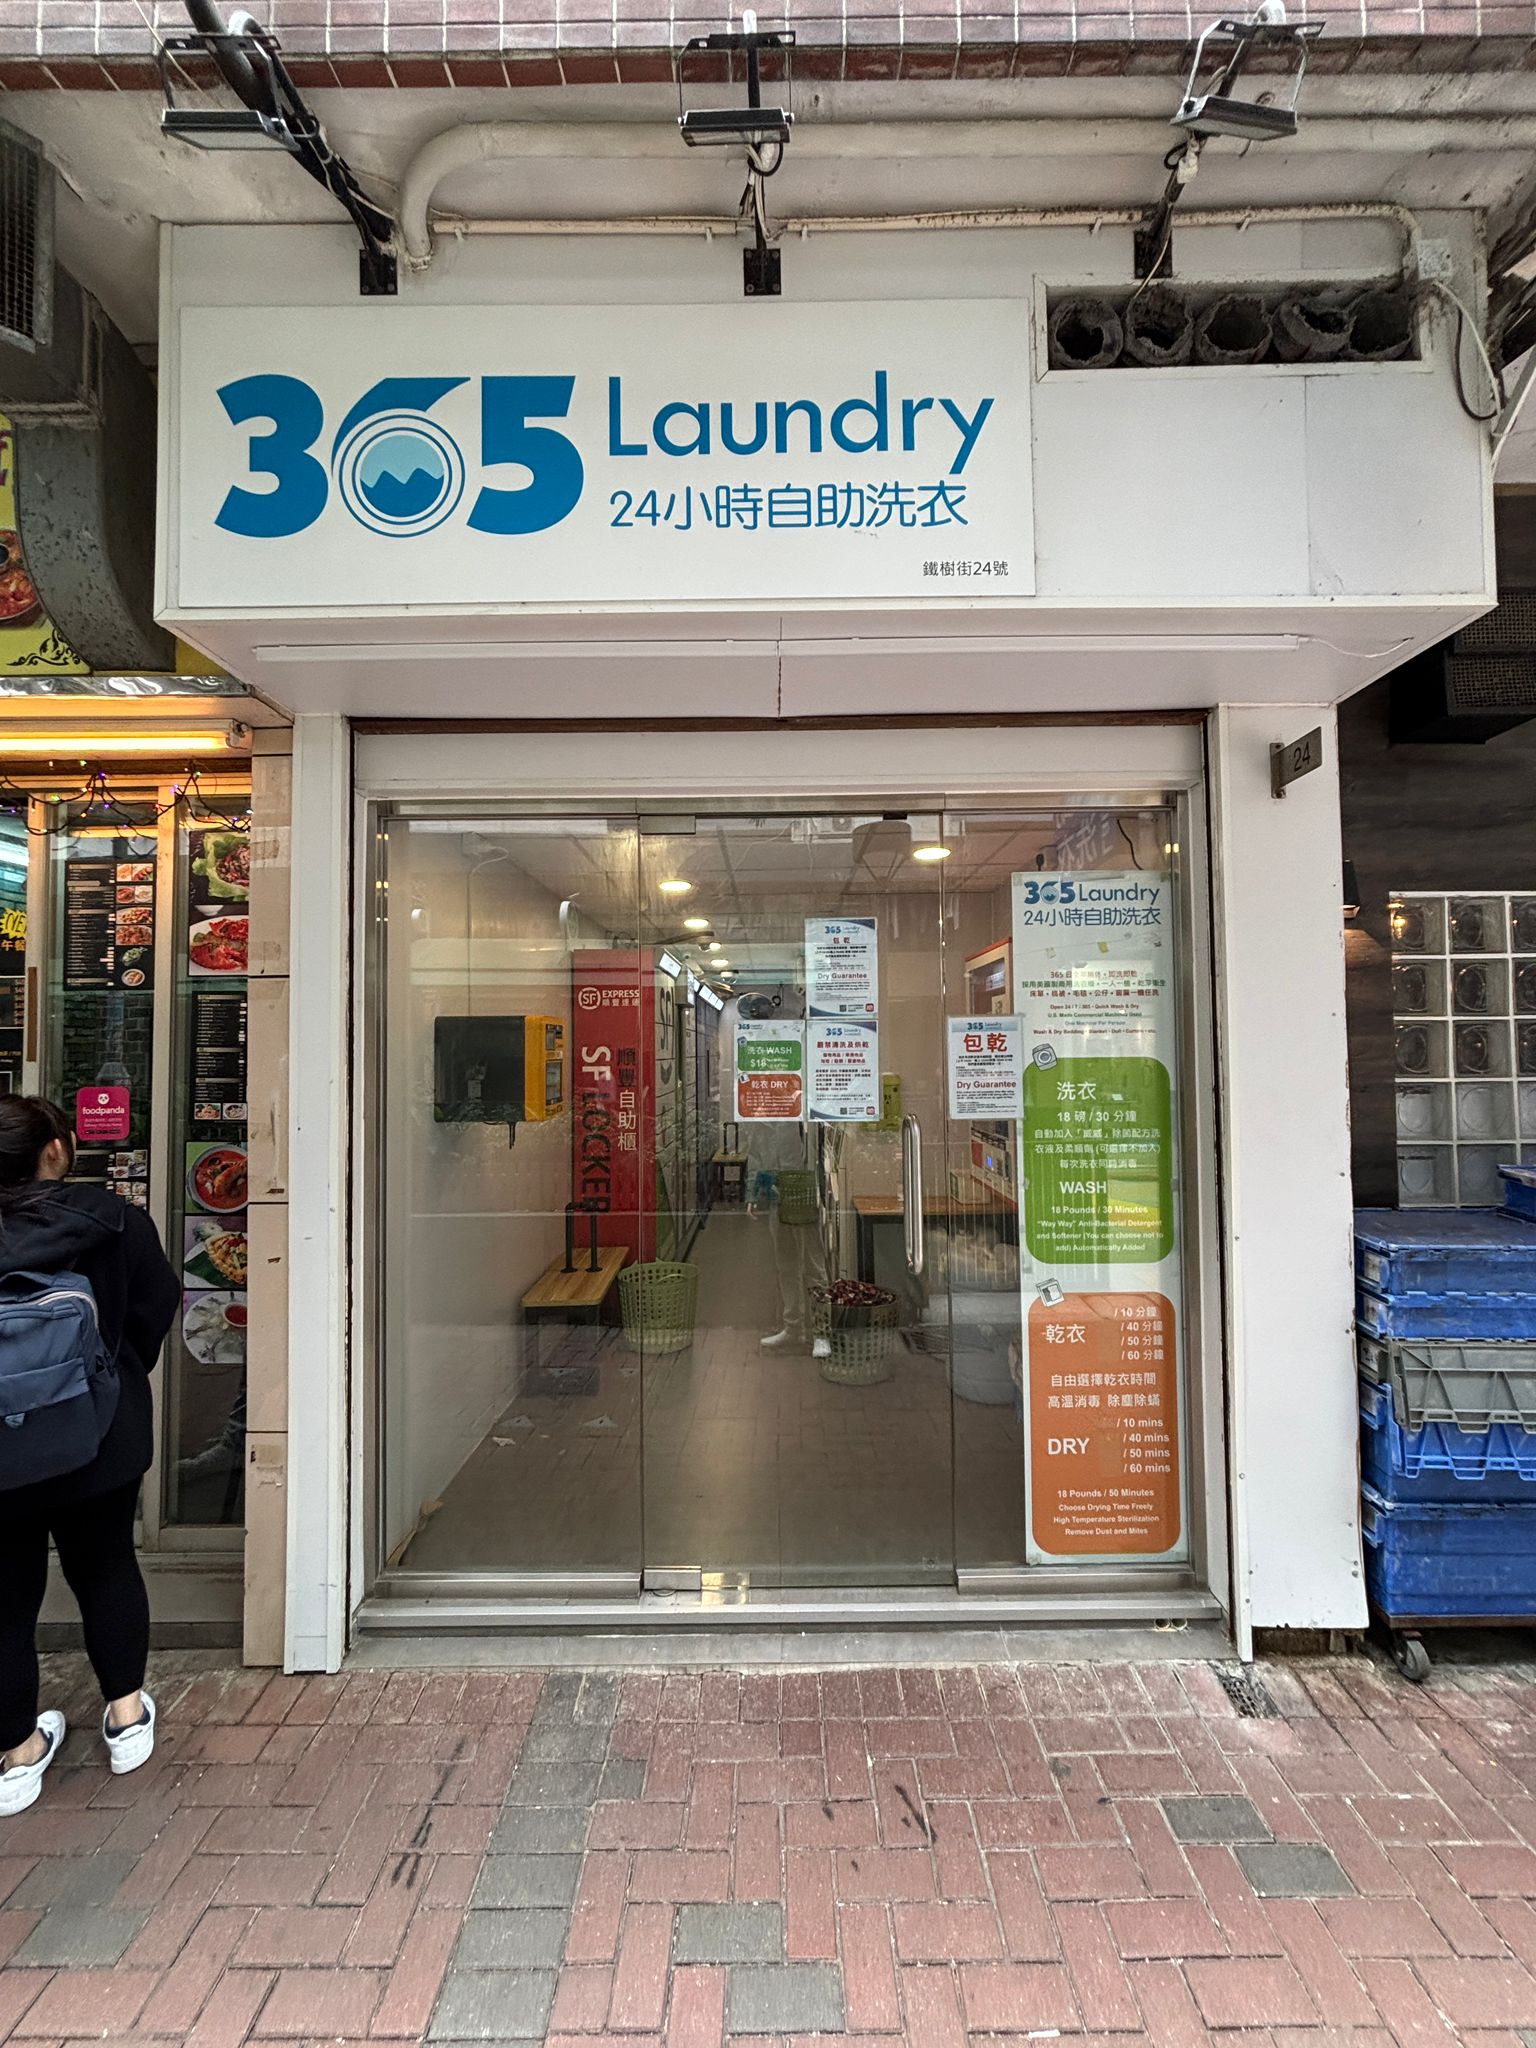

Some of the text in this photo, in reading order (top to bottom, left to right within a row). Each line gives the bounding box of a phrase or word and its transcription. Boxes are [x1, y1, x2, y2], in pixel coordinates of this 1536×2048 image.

[214, 370, 995, 538] 365 Laundry
[610, 480, 968, 530] 24小時自助洗衣
[922, 561, 1009, 576] 鐵樹街24號
[1293, 741, 1311, 772] 24
[1023, 880, 1160, 907] 365 Laundry
[1023, 907, 1162, 927] 24小時自助洗衣
[5, 913, 27, 933] NE
[602, 989, 640, 998] EXPRESS
[967, 1022, 984, 1031] 365
[826, 1028, 843, 1036] 365
[766, 1046, 793, 1055] WASH
[581, 1046, 611, 1081] SF
[770, 1080, 789, 1089] DRY
[956, 1080, 1017, 1090] Dry Guarantee
[1056, 1082, 1097, 1101] 洗衣
[82, 1106, 125, 1116] foodpanda
[1057, 1111, 1071, 1122] 18
[1095, 1111, 1110, 1122] 30
[1059, 1181, 1107, 1194] WASH
[1051, 1205, 1061, 1214] 18
[1063, 1205, 1096, 1214] Pounds
[1102, 1205, 1113, 1214] 30
[1115, 1205, 1148, 1214] Minutes
[1051, 1232, 1081, 1240] Softener
[1073, 1243, 1121, 1252] Automatically
[1121, 1307, 1133, 1317] 10
[1126, 1322, 1139, 1332] 40
[1045, 1323, 1086, 1344] 乾衣
[1127, 1336, 1140, 1346] 50
[1127, 1350, 1140, 1360] 60
[1116, 1417, 1164, 1428] / 10 mins
[1122, 1432, 1170, 1443] / 40 mins
[1047, 1437, 1090, 1455] DRY
[1123, 1448, 1171, 1458] / 50 mins
[1123, 1463, 1171, 1473] / 60 mins
[1057, 1489, 1154, 1498] 18 Pounds / 50 Minutes
[1058, 1503, 1153, 1511] Choose Drying Time Freely
[1053, 1516, 1159, 1524] High Temperature Sterilization
